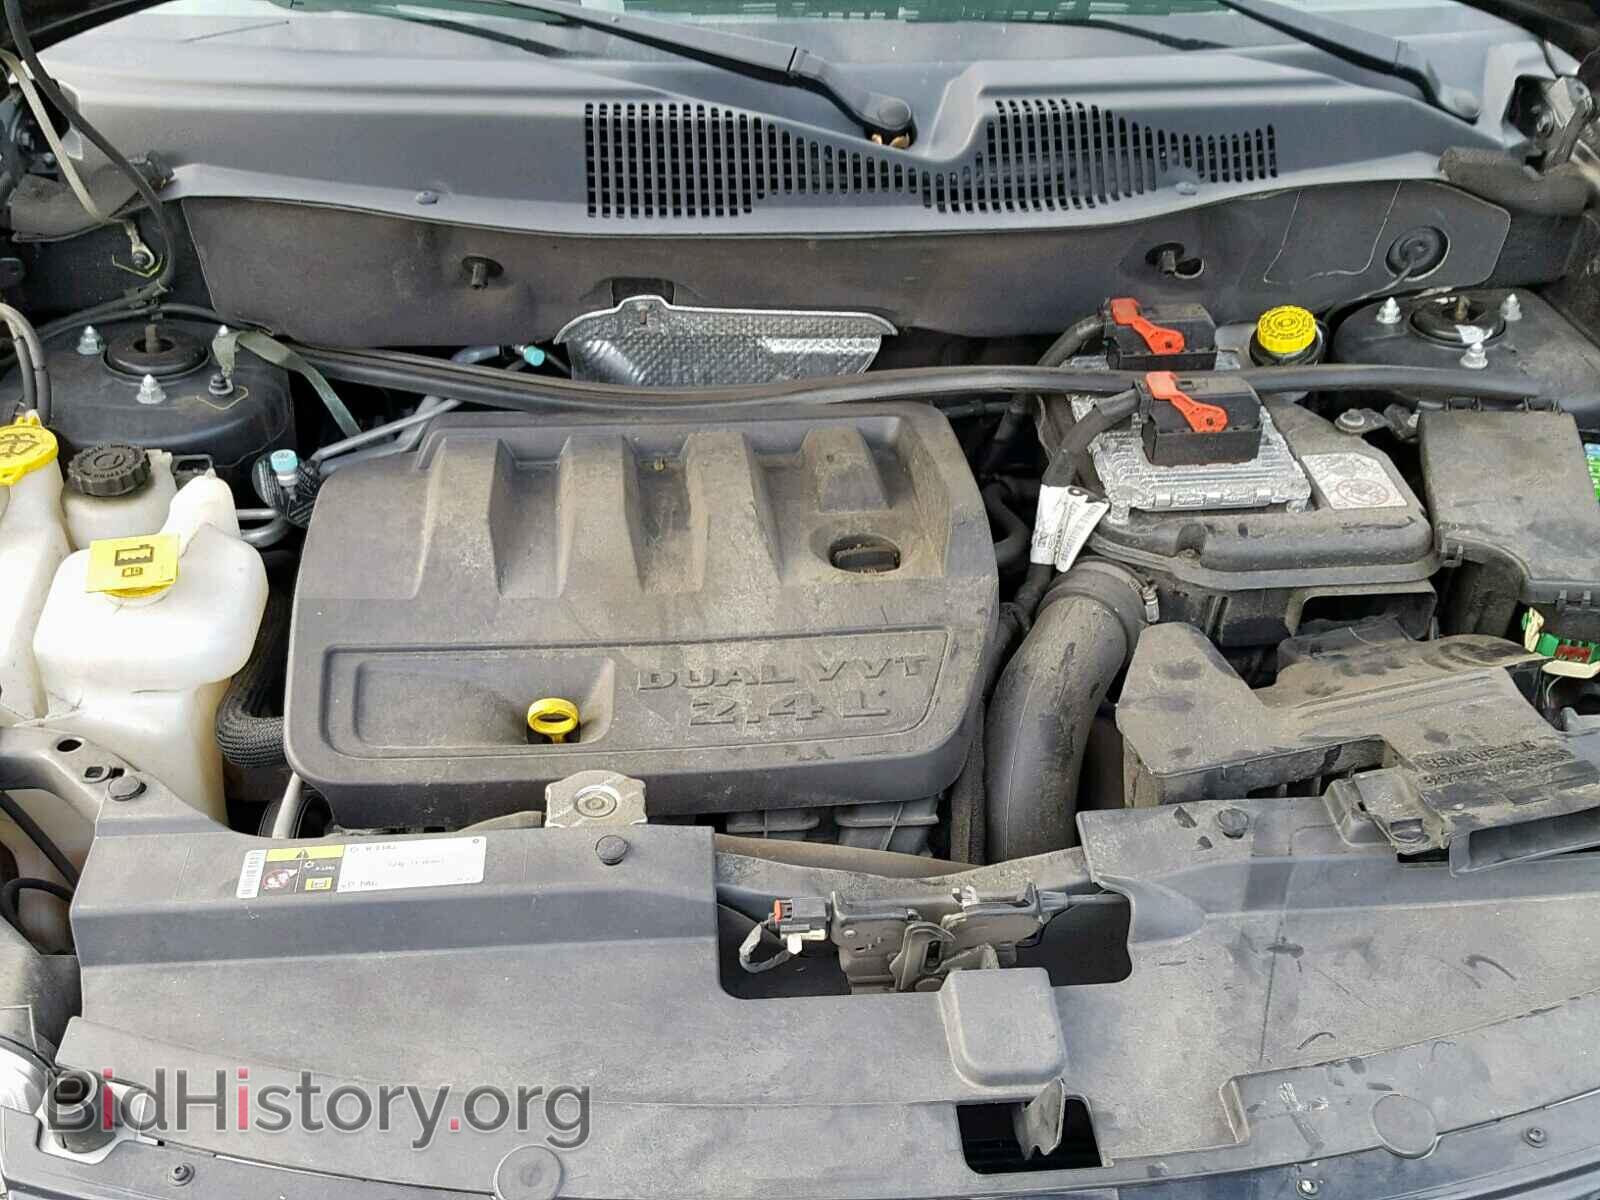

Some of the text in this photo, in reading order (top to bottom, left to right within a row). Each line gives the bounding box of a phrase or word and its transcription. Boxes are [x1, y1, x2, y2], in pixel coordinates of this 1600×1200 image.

[638, 656, 927, 690] DUAL VVT
[688, 690, 890, 727] 2.4L
